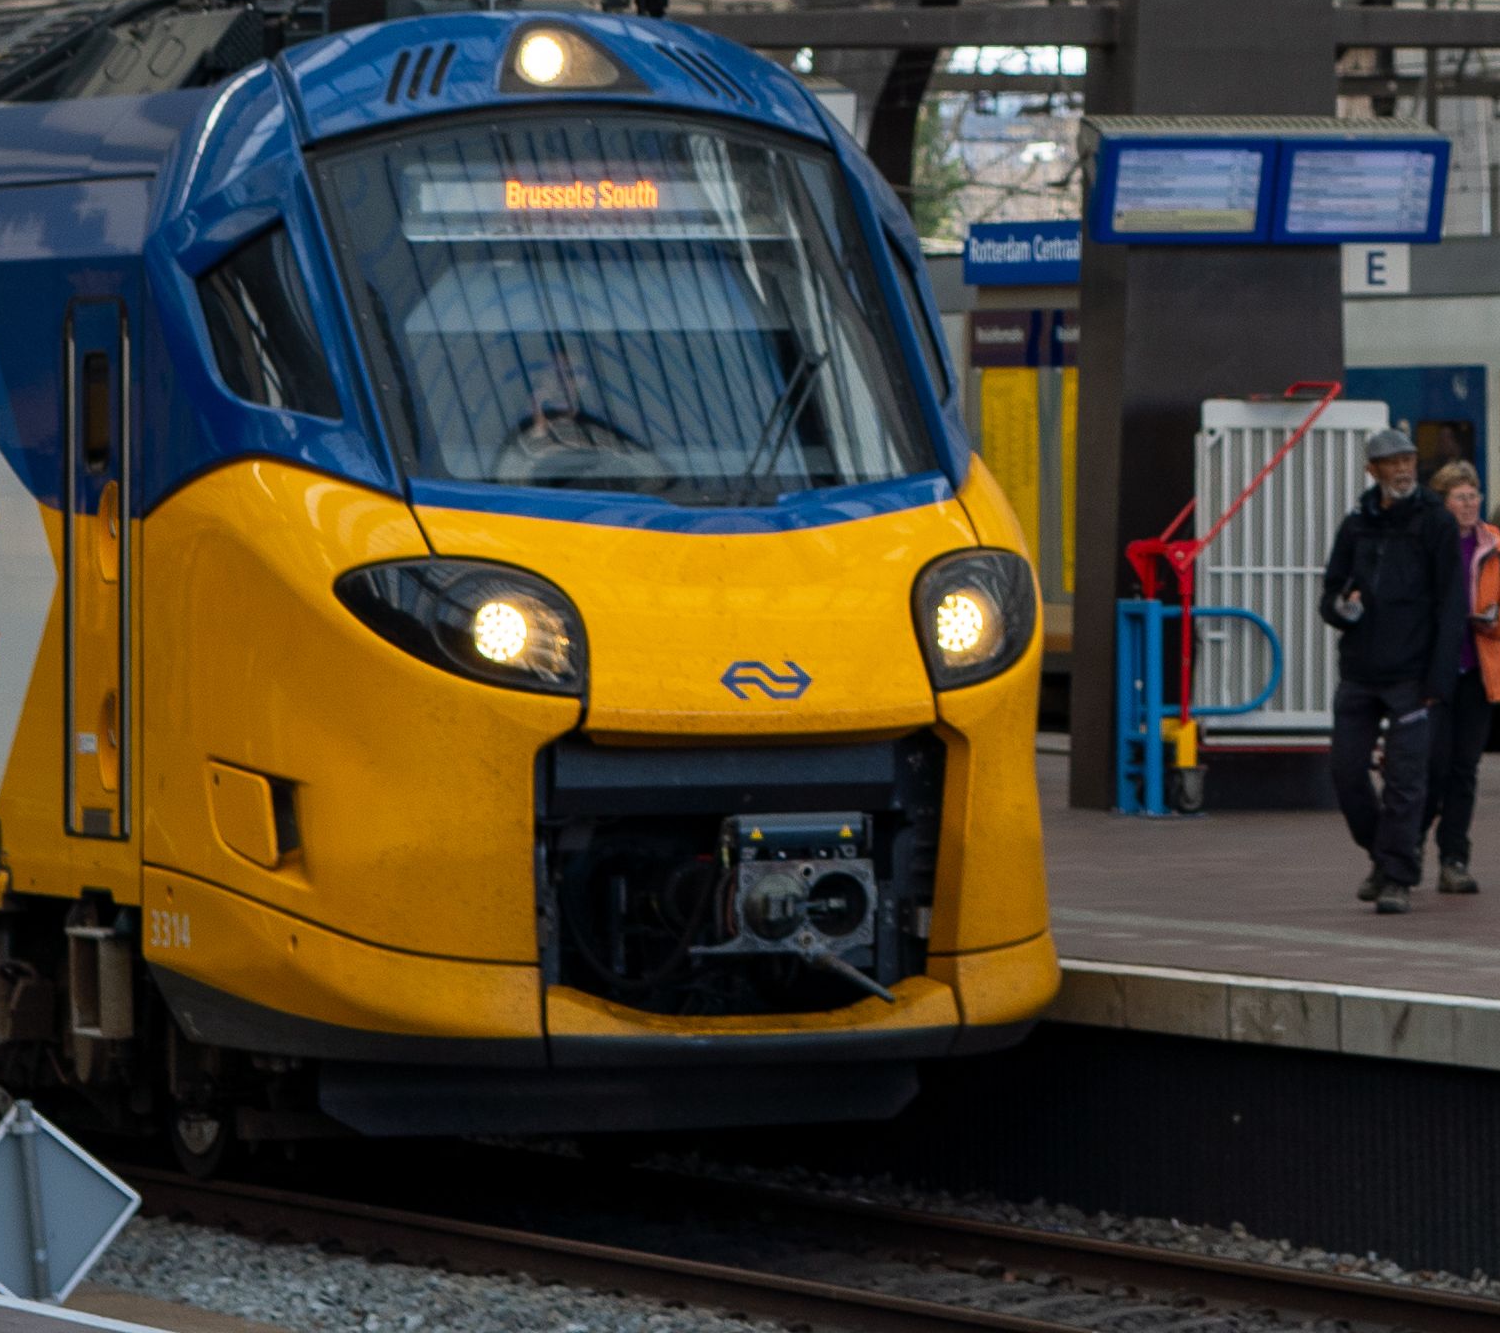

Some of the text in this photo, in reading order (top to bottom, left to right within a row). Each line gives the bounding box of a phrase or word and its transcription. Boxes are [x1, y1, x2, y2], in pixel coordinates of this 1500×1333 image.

[506, 179, 659, 209] Brussels South
[969, 234, 1032, 264] Rotterdam
[1366, 249, 1387, 286] E
[149, 907, 192, 950] 3314
